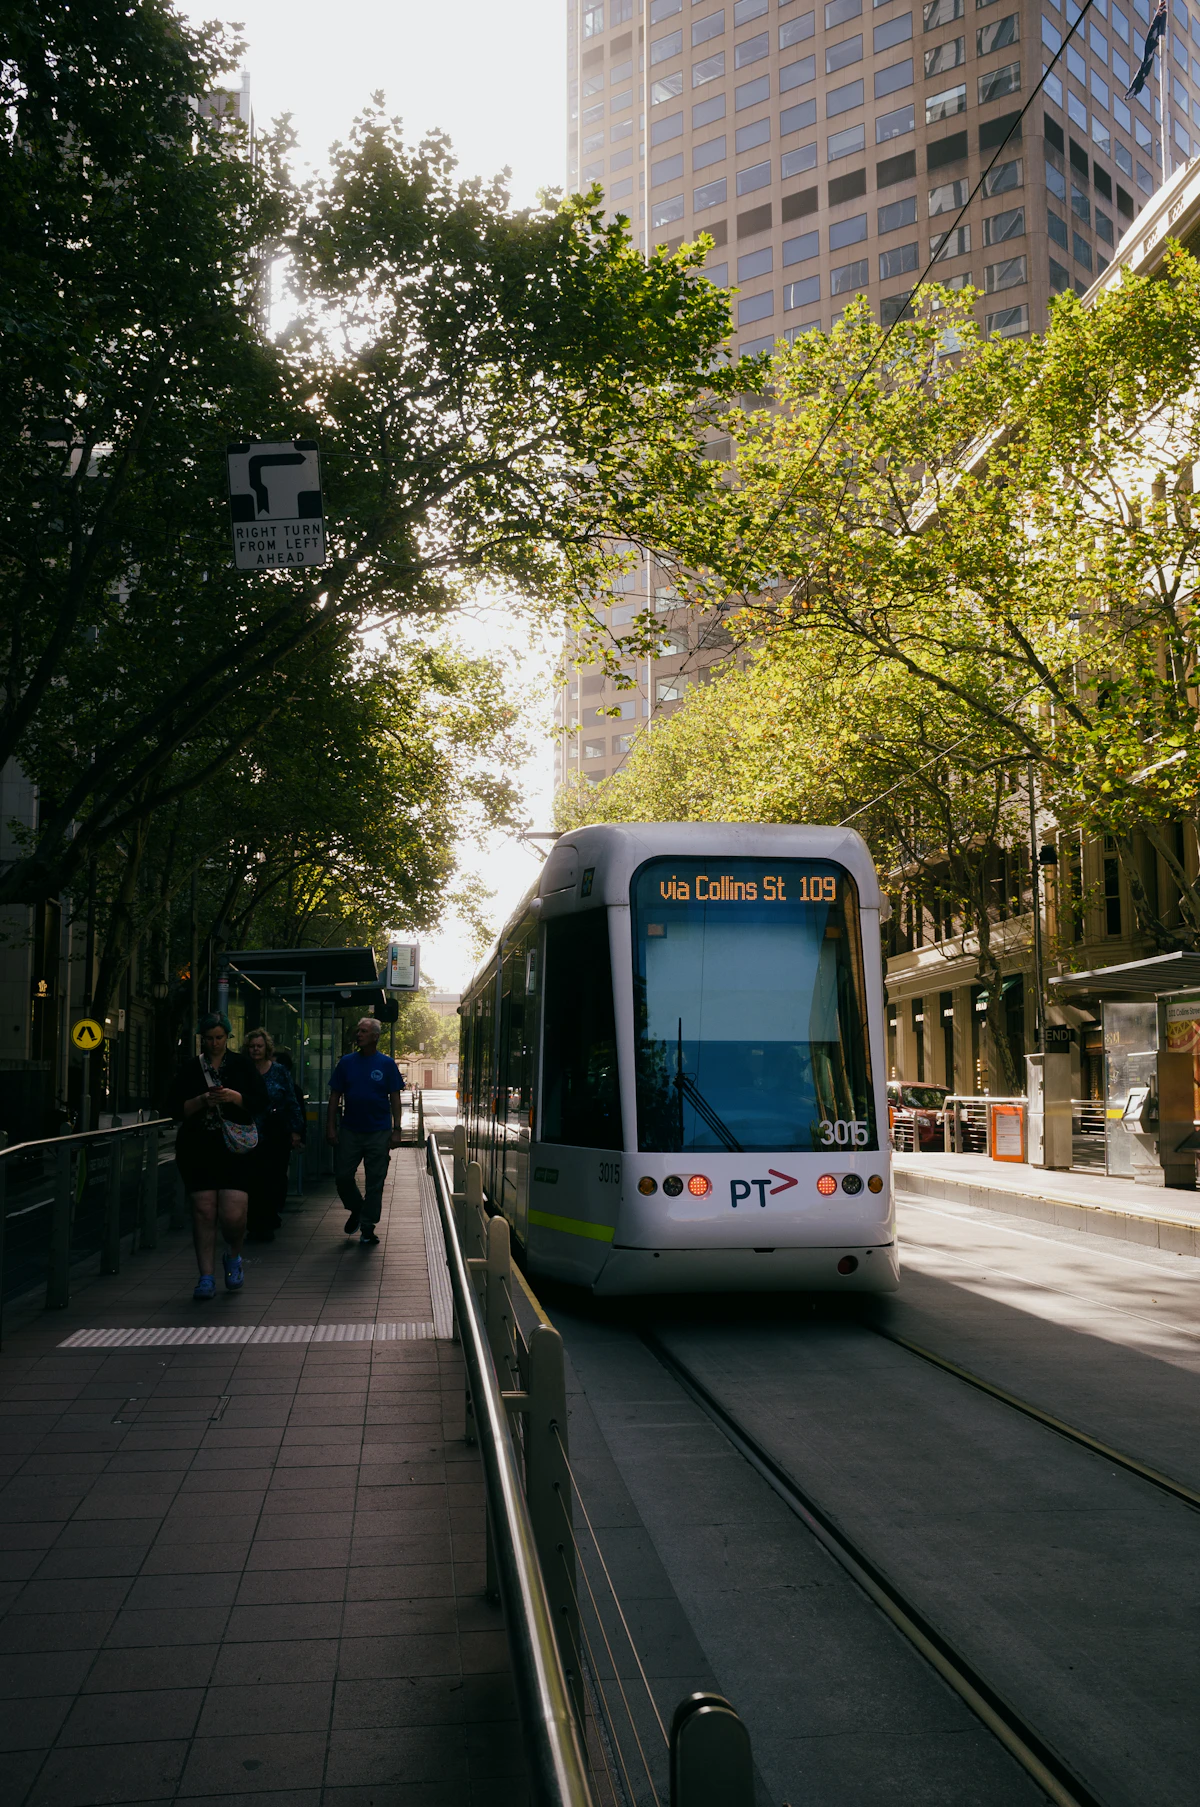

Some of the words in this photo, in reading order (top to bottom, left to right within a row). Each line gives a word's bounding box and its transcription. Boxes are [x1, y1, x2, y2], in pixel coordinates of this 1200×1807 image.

[236, 526, 277, 539] RIGHT
[283, 524, 320, 536] TURN
[239, 540, 276, 552] FROM
[286, 537, 318, 550] LEFT
[256, 552, 304, 565] AHEAD
[660, 875, 690, 900] via
[695, 875, 758, 901] Collins
[763, 875, 787, 901] St
[799, 876, 837, 901] 109
[1045, 1029, 1072, 1041] ENDI
[819, 1120, 868, 1147] 3015
[598, 1162, 620, 1185] 3015
